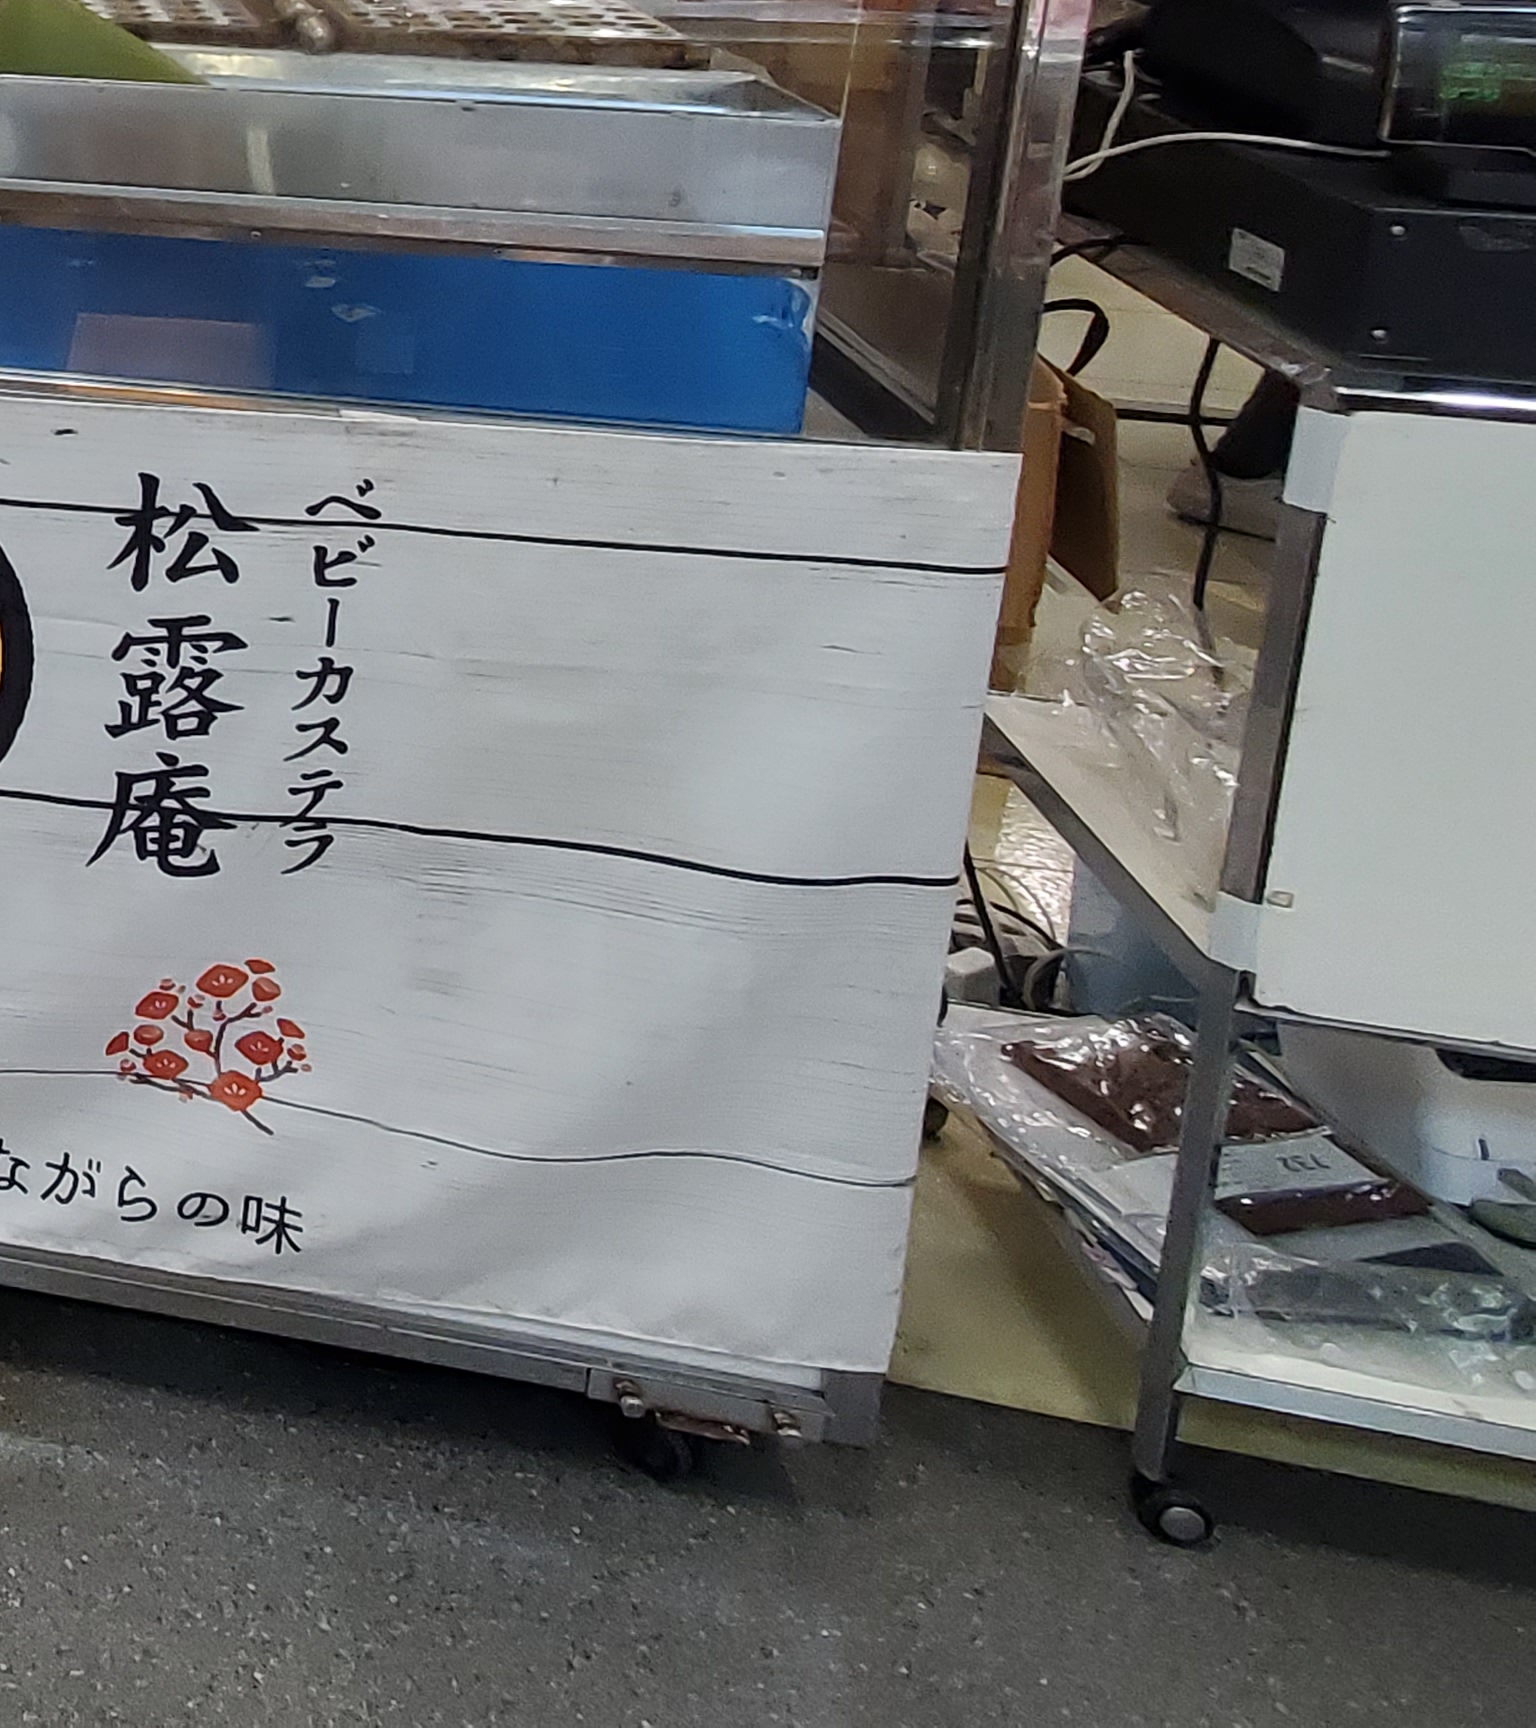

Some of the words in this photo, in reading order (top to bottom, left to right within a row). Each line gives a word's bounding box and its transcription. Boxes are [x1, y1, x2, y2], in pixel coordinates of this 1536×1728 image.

[85, 472, 259, 878] 松露庵
[280, 478, 379, 875] ベビーカステラ
